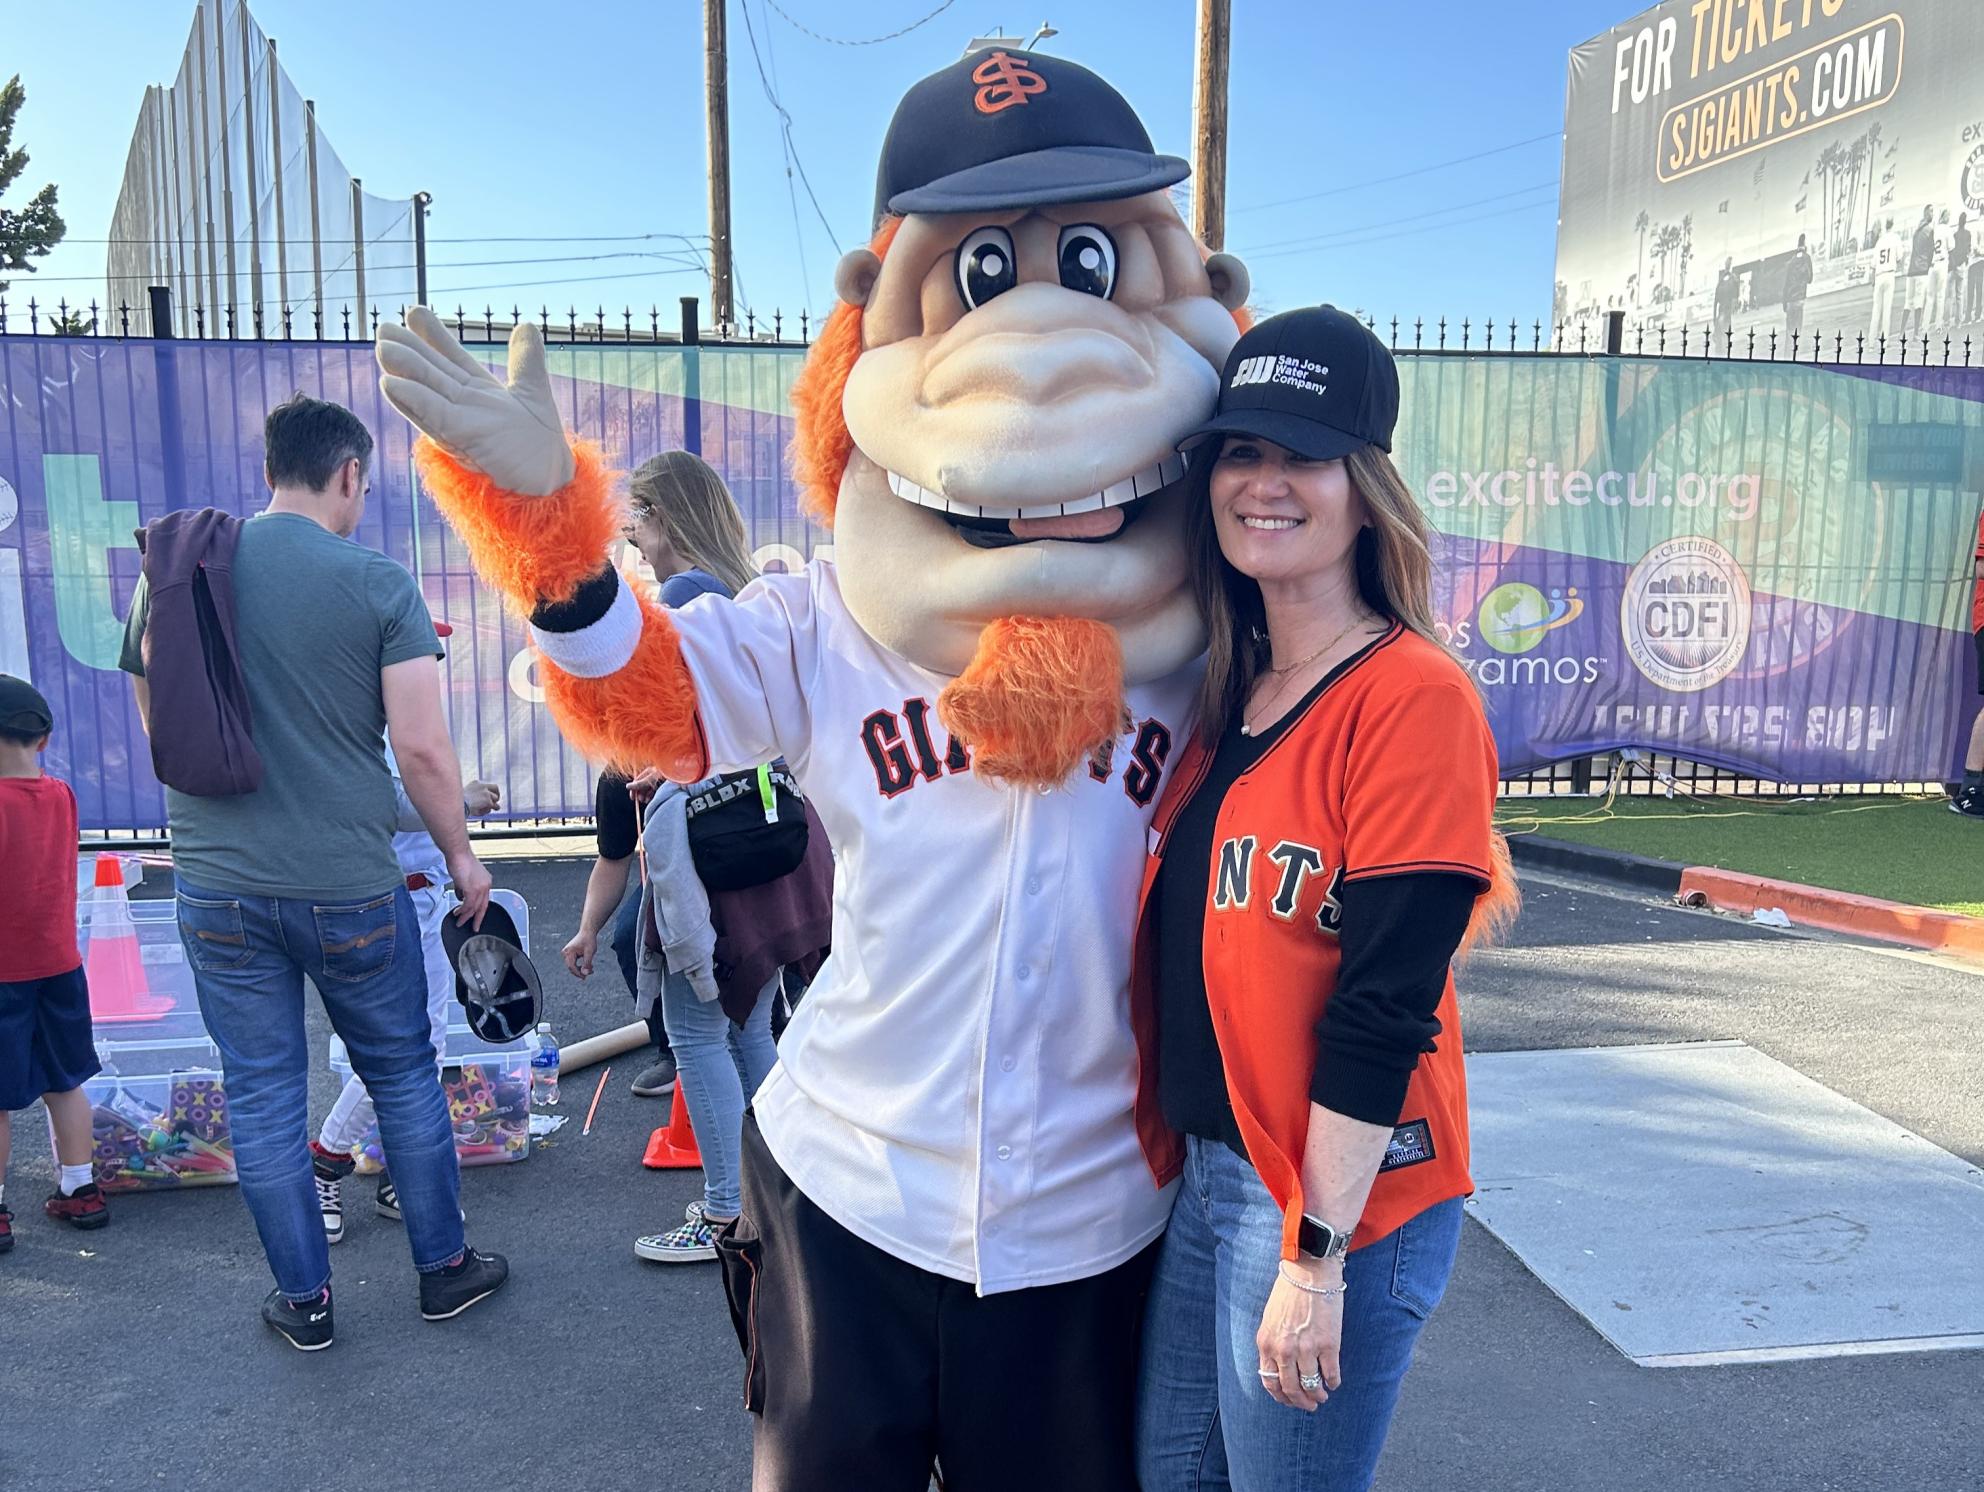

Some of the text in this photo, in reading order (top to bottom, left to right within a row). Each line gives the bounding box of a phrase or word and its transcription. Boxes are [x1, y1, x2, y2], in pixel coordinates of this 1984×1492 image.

[1611, 0, 1845, 115] FOR TICKE
[1669, 28, 1886, 170] SJGIANTS.COM
[1961, 121, 1984, 143] ex
[1879, 248, 1891, 264] 51
[1275, 364, 1309, 380] Water
[1277, 354, 1329, 375] San Jose
[1272, 373, 1327, 395] Company
[1426, 462, 1762, 521] excitecu.org
[1660, 540, 1722, 560] CERTIFIED
[1644, 600, 1729, 638] CDFI
[1642, 659, 1693, 687] Department
